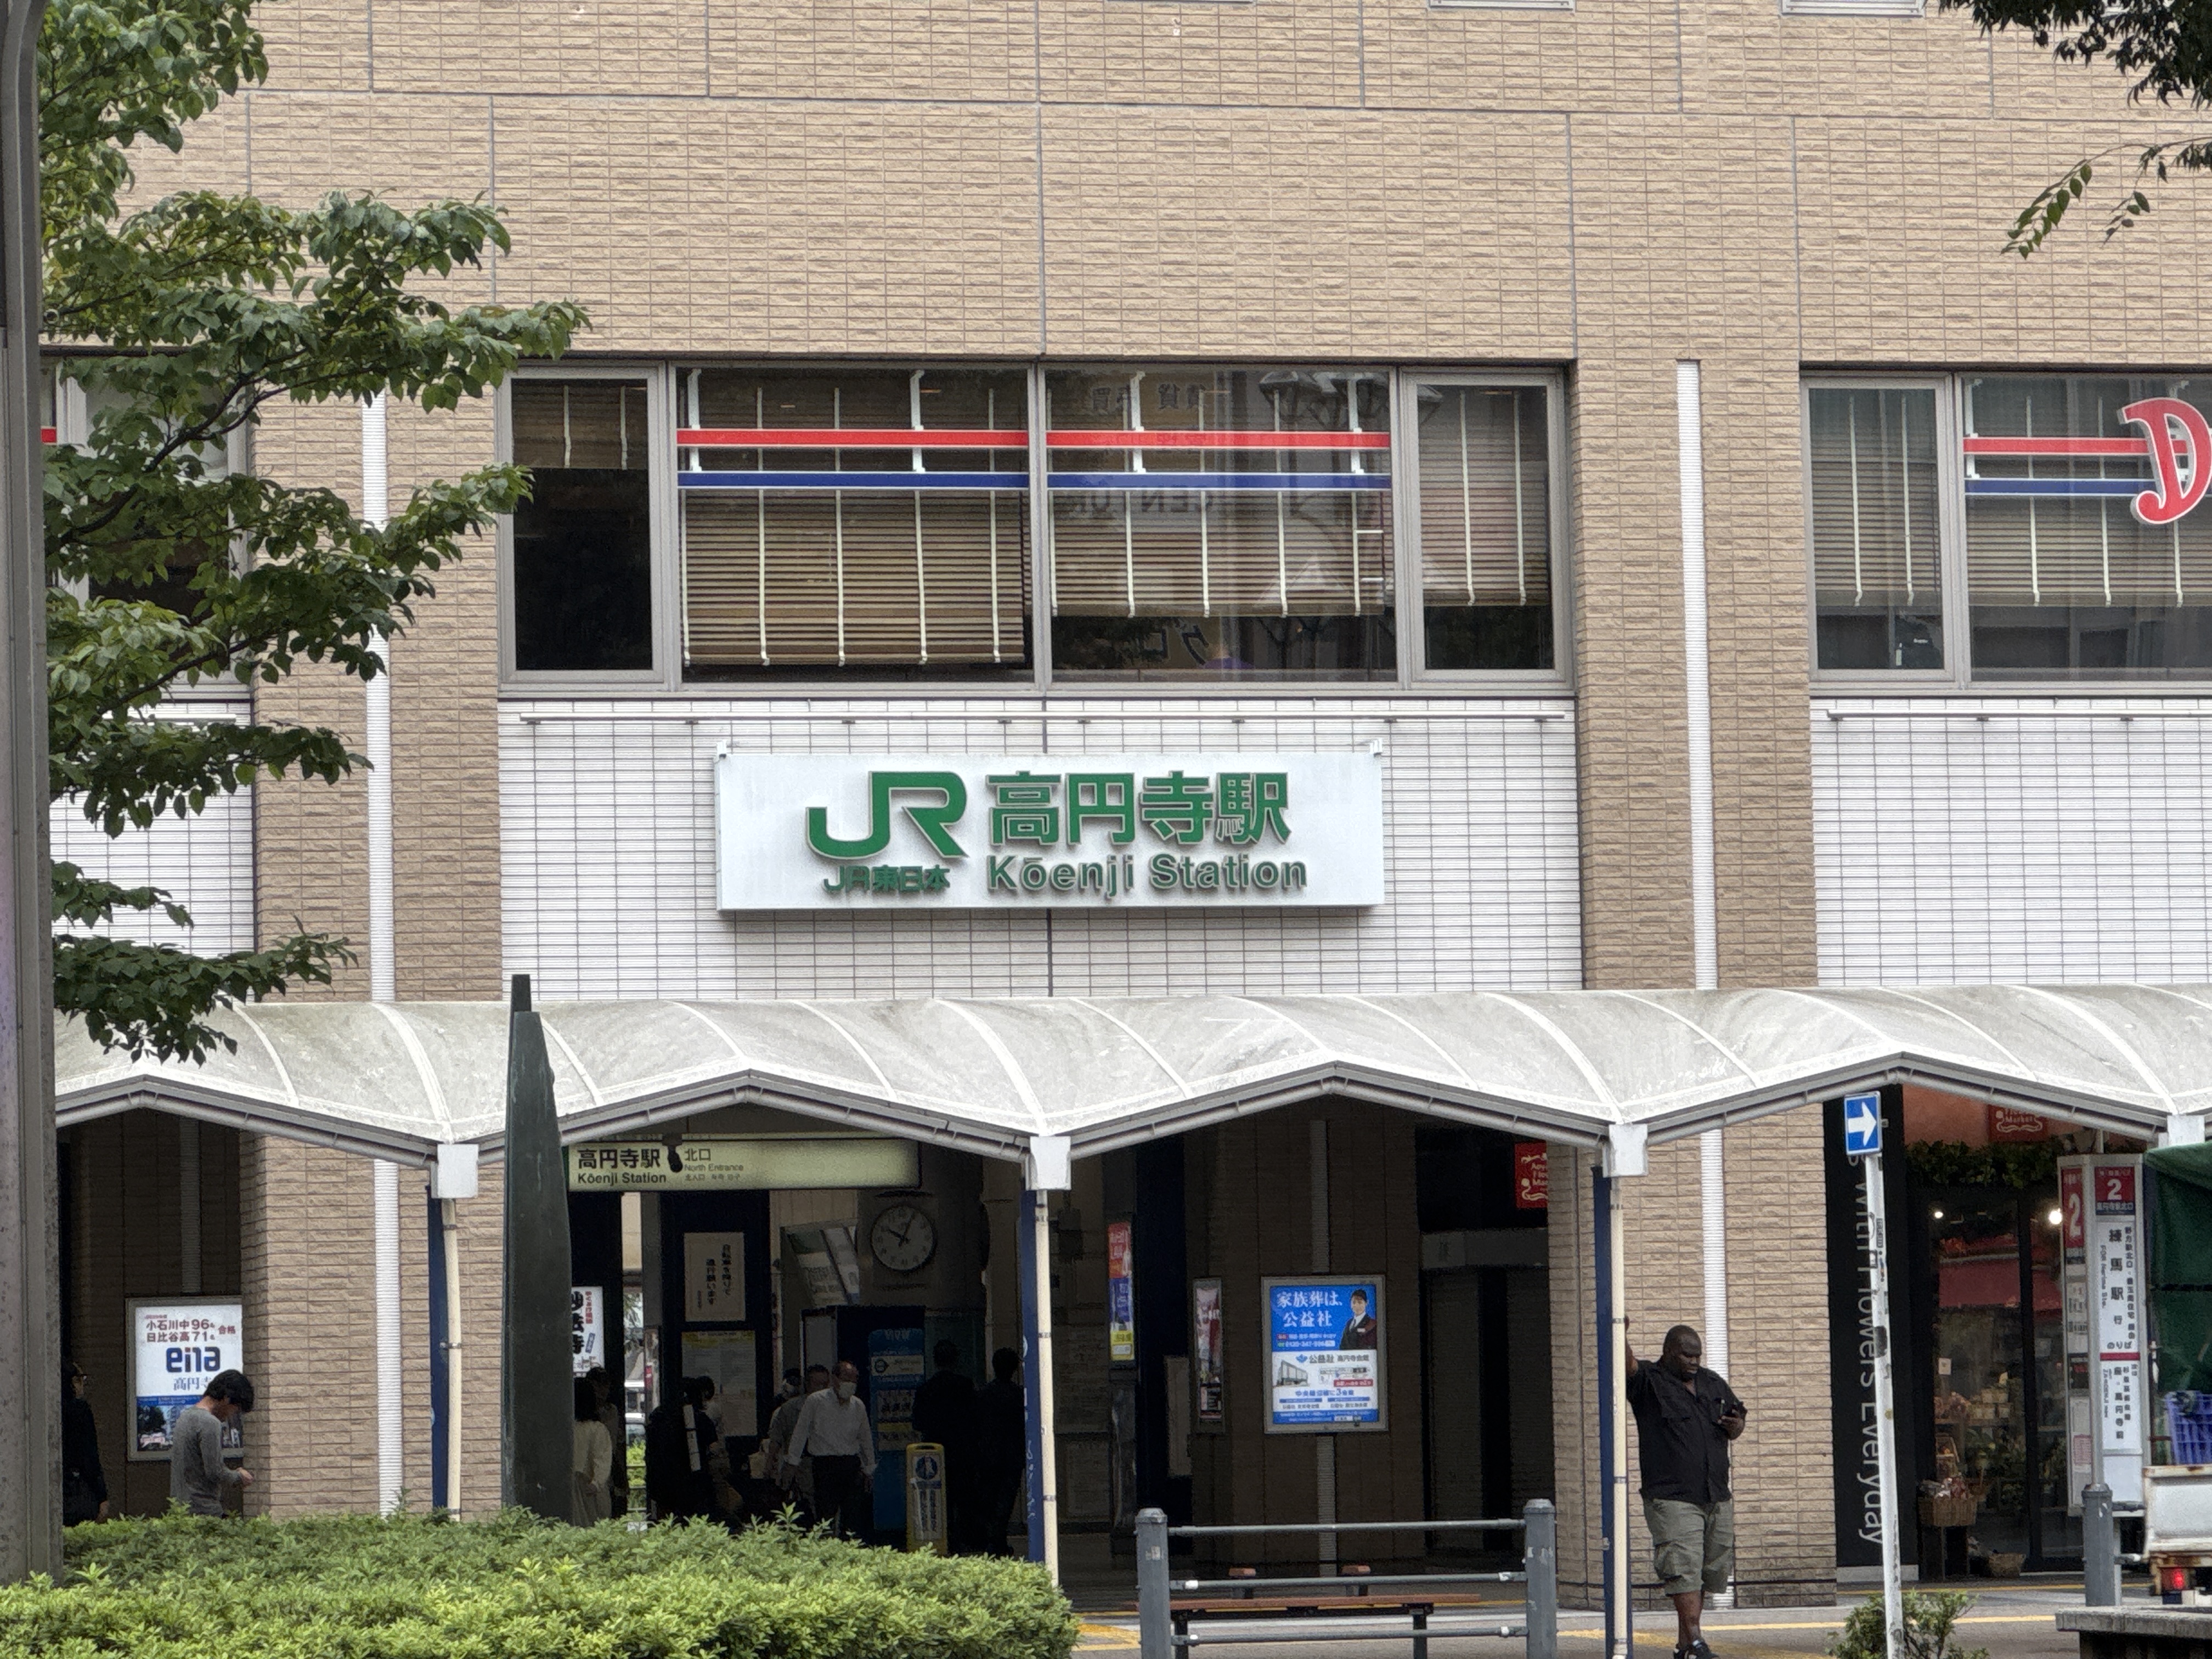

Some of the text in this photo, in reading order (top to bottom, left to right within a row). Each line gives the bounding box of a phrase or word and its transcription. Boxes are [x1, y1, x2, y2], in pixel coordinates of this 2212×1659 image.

[2119, 397, 2212, 524] D
[806, 771, 969, 859] JR
[986, 771, 1293, 845] 高円寺駅
[823, 865, 951, 893] JR東日本
[988, 853, 1307, 900] Kōenji Station
[578, 1149, 661, 1169] 高円寺駅
[685, 1148, 711, 1161] 北口
[622, 1172, 667, 1184] Station
[2107, 1178, 2122, 1200] 2
[2069, 1193, 2081, 1237] 2
[218, 1325, 236, 1335] 合格
[1283, 1310, 1332, 1328] 公益社
